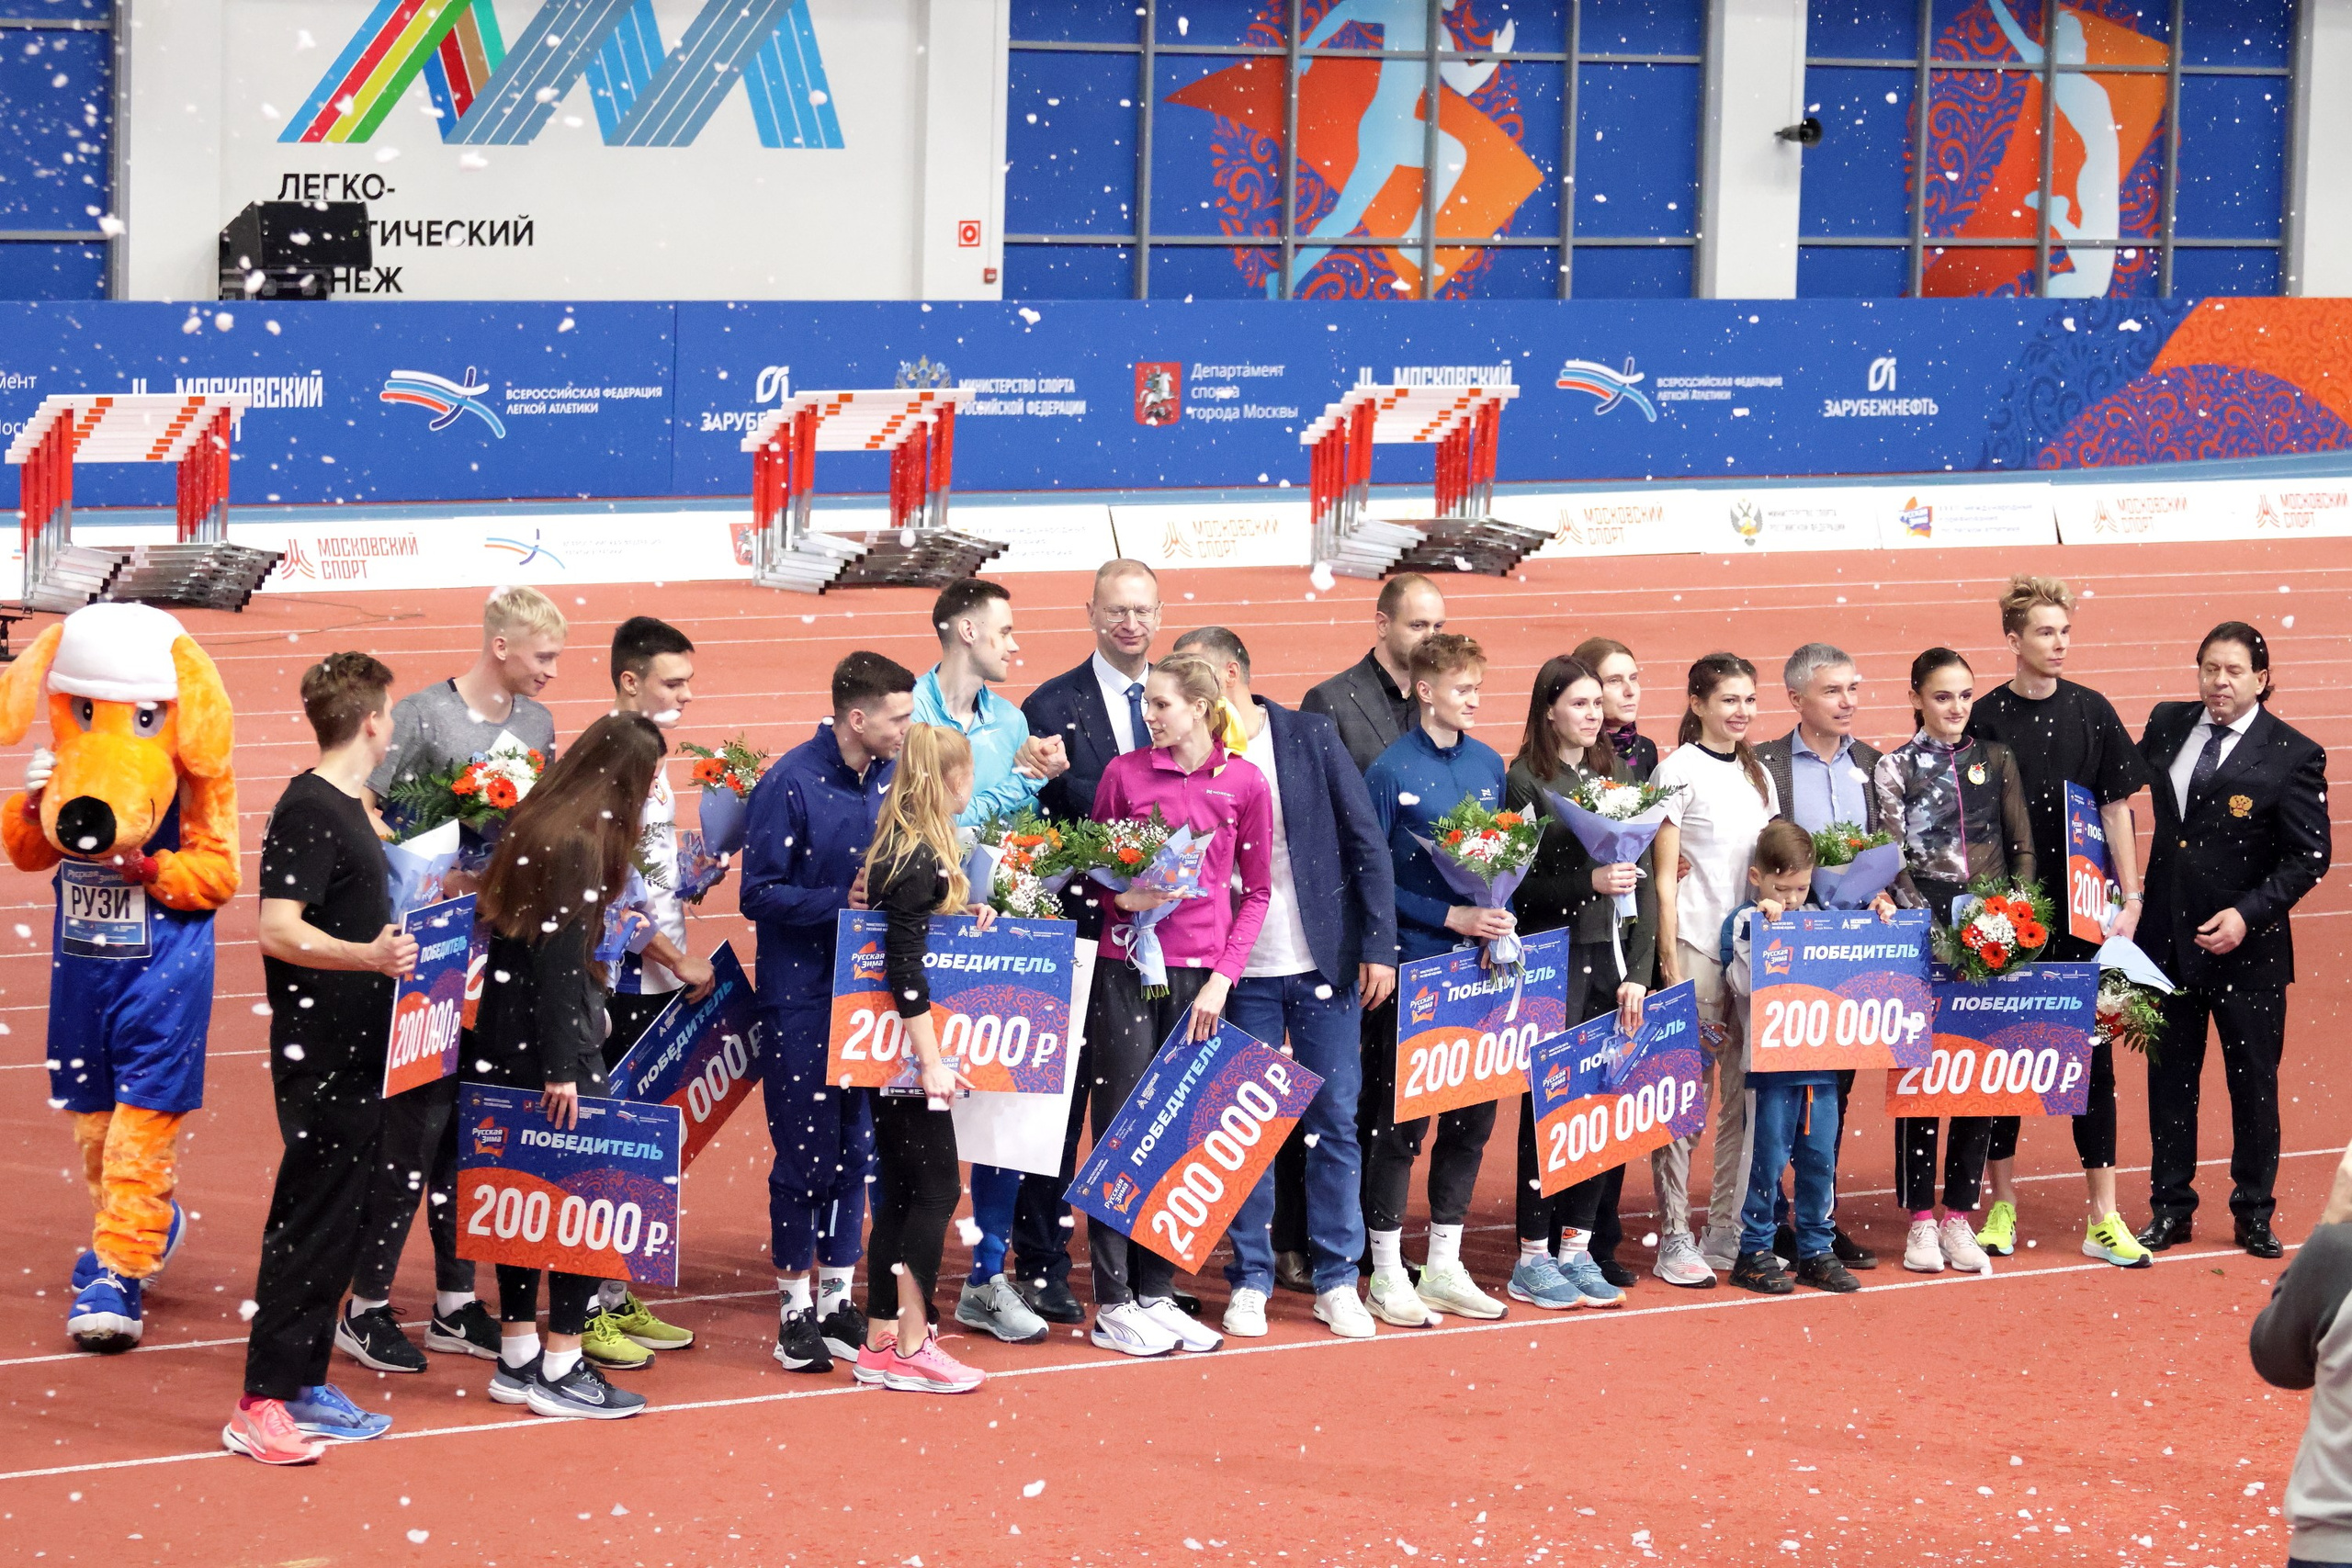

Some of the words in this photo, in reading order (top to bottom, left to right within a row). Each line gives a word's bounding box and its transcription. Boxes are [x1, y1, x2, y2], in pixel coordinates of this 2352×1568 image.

[277, 173, 396, 201] ЛЕГКО-
[368, 214, 535, 247] ТИЧЕСКИЙ
[330, 266, 403, 293] НЕЖ
[1190, 363, 1286, 381] Департамент
[1393, 359, 1513, 386] МОСКОВСКИЙ
[505, 387, 600, 401] ВСЕРОССИЙСКАЯ
[602, 386, 663, 400] ФЕДЕРАЦИЯ
[505, 401, 546, 416] ЛЕГКОЙ
[548, 401, 599, 415] АТЛЕТИКИ
[1189, 406, 1240, 423] города
[1242, 403, 1299, 419] Москвы
[1823, 398, 1939, 418] ЗАРУБЕЖНЕФТЬ
[700, 412, 767, 432] ЗАРУБЕ
[317, 532, 419, 558] МОСКОВСКИЙ
[1197, 539, 1237, 558] СПОРТ
[1588, 526, 1624, 545] СПОРТ
[322, 559, 368, 580] СПОРТ
[72, 886, 130, 919] РУЗИ
[420, 935, 468, 964] ПОБЕДИТЕЛЬ
[851, 953, 886, 964] Русская
[1763, 948, 1789, 960] Русская
[1803, 943, 1920, 962] ПОБЕДИТЕЛЬ
[922, 952, 1057, 974] ОБЕДИТЕЛЬ
[1409, 994, 1435, 1010] Русская
[1951, 997, 2084, 1013] ПОБЕДИТЕЛЬ
[1760, 999, 1830, 1047] 200
[1835, 998, 1905, 1046] 000
[391, 1008, 426, 1069] 200
[637, 979, 734, 1096] ПОБЕДИТЕЛЬ
[940, 1013, 1031, 1067] 000
[1404, 1038, 1470, 1099] 200
[1474, 1022, 1539, 1081] 000
[1895, 1049, 1976, 1095] 200
[1980, 1048, 2060, 1094] 000
[1543, 1069, 1566, 1088] Русская
[1130, 1035, 1222, 1167] ПОБЕДИТЕЛЬ
[471, 1127, 503, 1137] Русская
[1547, 1105, 1609, 1173] 200
[1614, 1076, 1676, 1142] 000
[520, 1129, 664, 1160] ПОБЕДИТЕЛЬ
[1151, 1161, 1225, 1255] 200
[1204, 1080, 1278, 1171] 000
[1103, 1178, 1125, 1210] Русская
[467, 1184, 551, 1243] 200
[557, 1195, 642, 1254] 000
